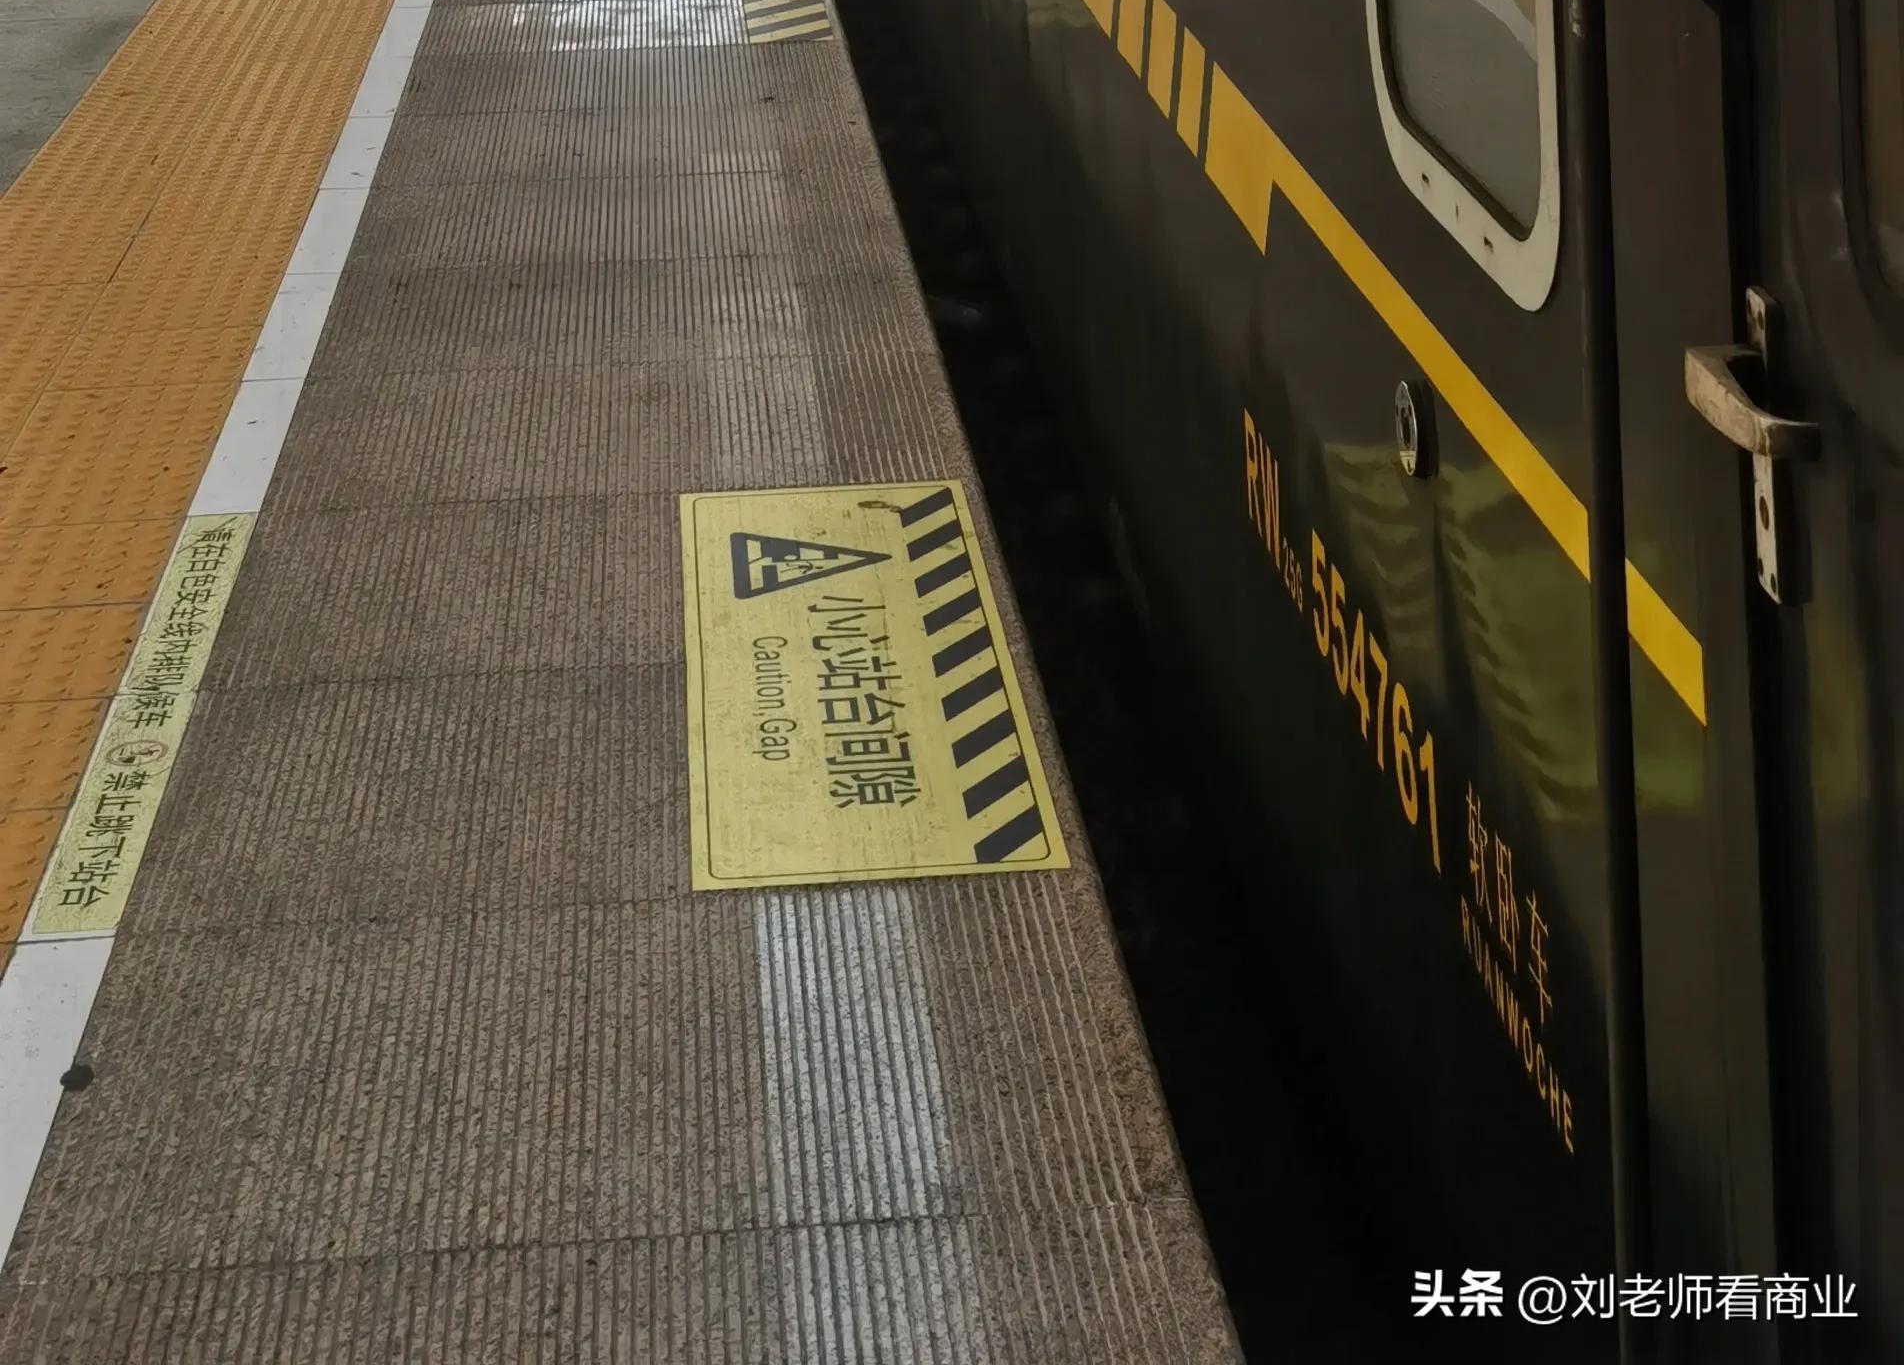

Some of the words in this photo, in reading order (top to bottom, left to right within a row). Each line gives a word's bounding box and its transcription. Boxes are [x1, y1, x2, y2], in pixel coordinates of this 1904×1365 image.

[127, 527, 235, 729] 请在白色安全线内排队候车
[806, 595, 922, 809] 小心站台间隙
[1311, 527, 1442, 876] 554761
[57, 770, 152, 909] 禁止跳下站台
[1465, 779, 1553, 1026] 软卧车
[1461, 893, 1575, 1157] RUANWOCHE
